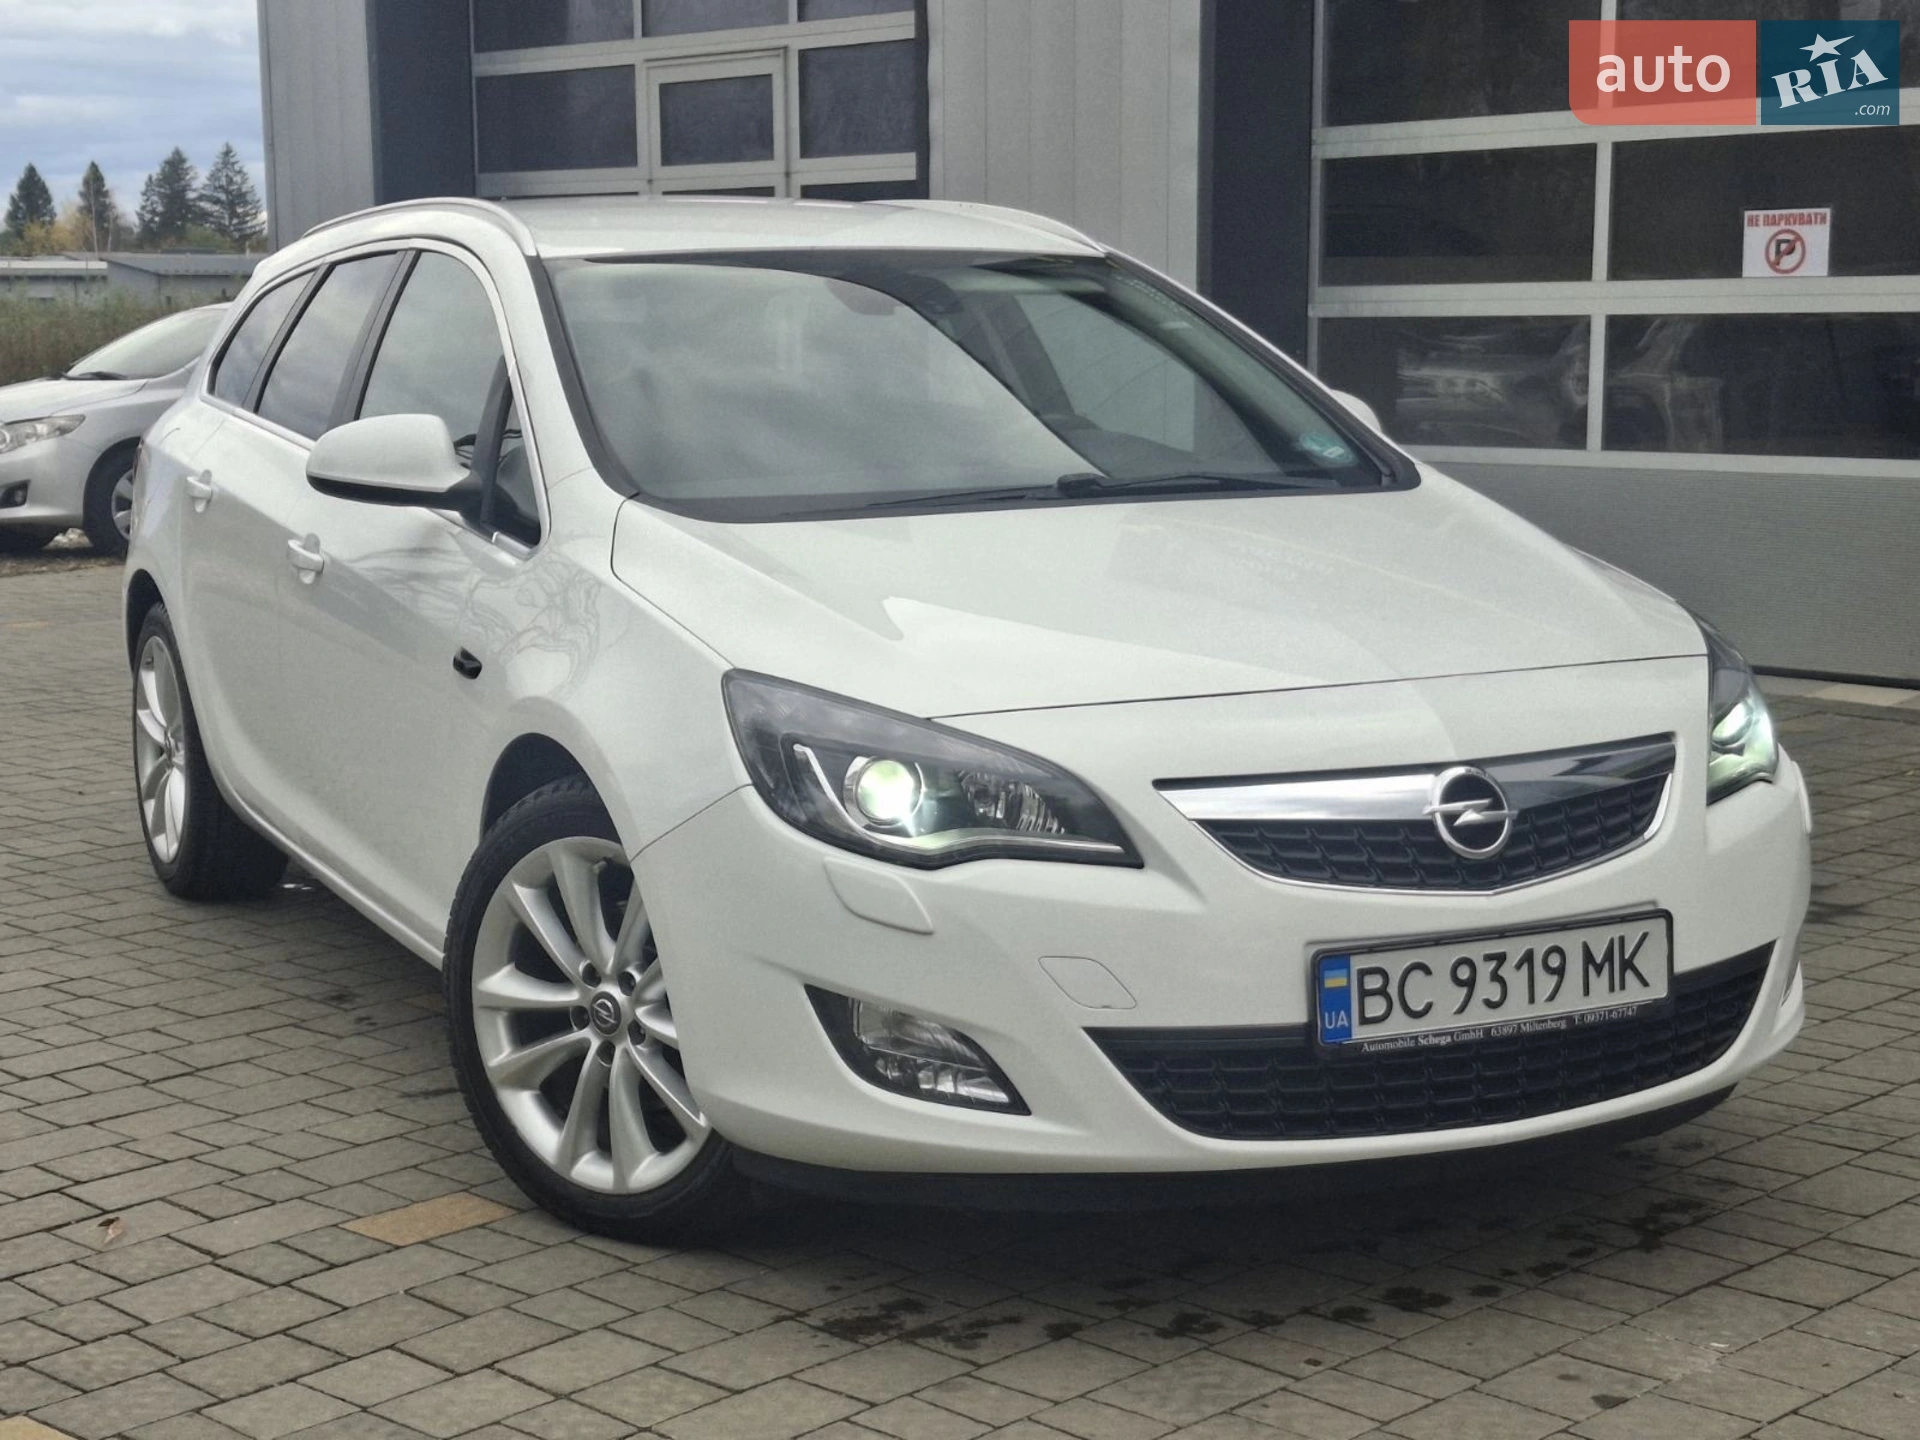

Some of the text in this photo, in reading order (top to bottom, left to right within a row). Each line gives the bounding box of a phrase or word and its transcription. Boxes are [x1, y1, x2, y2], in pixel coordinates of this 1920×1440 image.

[1747, 212, 1827, 227] НЕ ПАРКУВАТИ
[1357, 931, 1650, 1026] BC 9319 MK
[1325, 1012, 1349, 1029] UA
[1361, 1037, 1416, 1053] Automobile
[1417, 1033, 1452, 1046] Schega
[1453, 1028, 1484, 1042] GmbH
[1490, 1024, 1517, 1038] 63897
[1519, 1018, 1567, 1034] Miltenberg
[1583, 1006, 1638, 1024] 09371-67747
